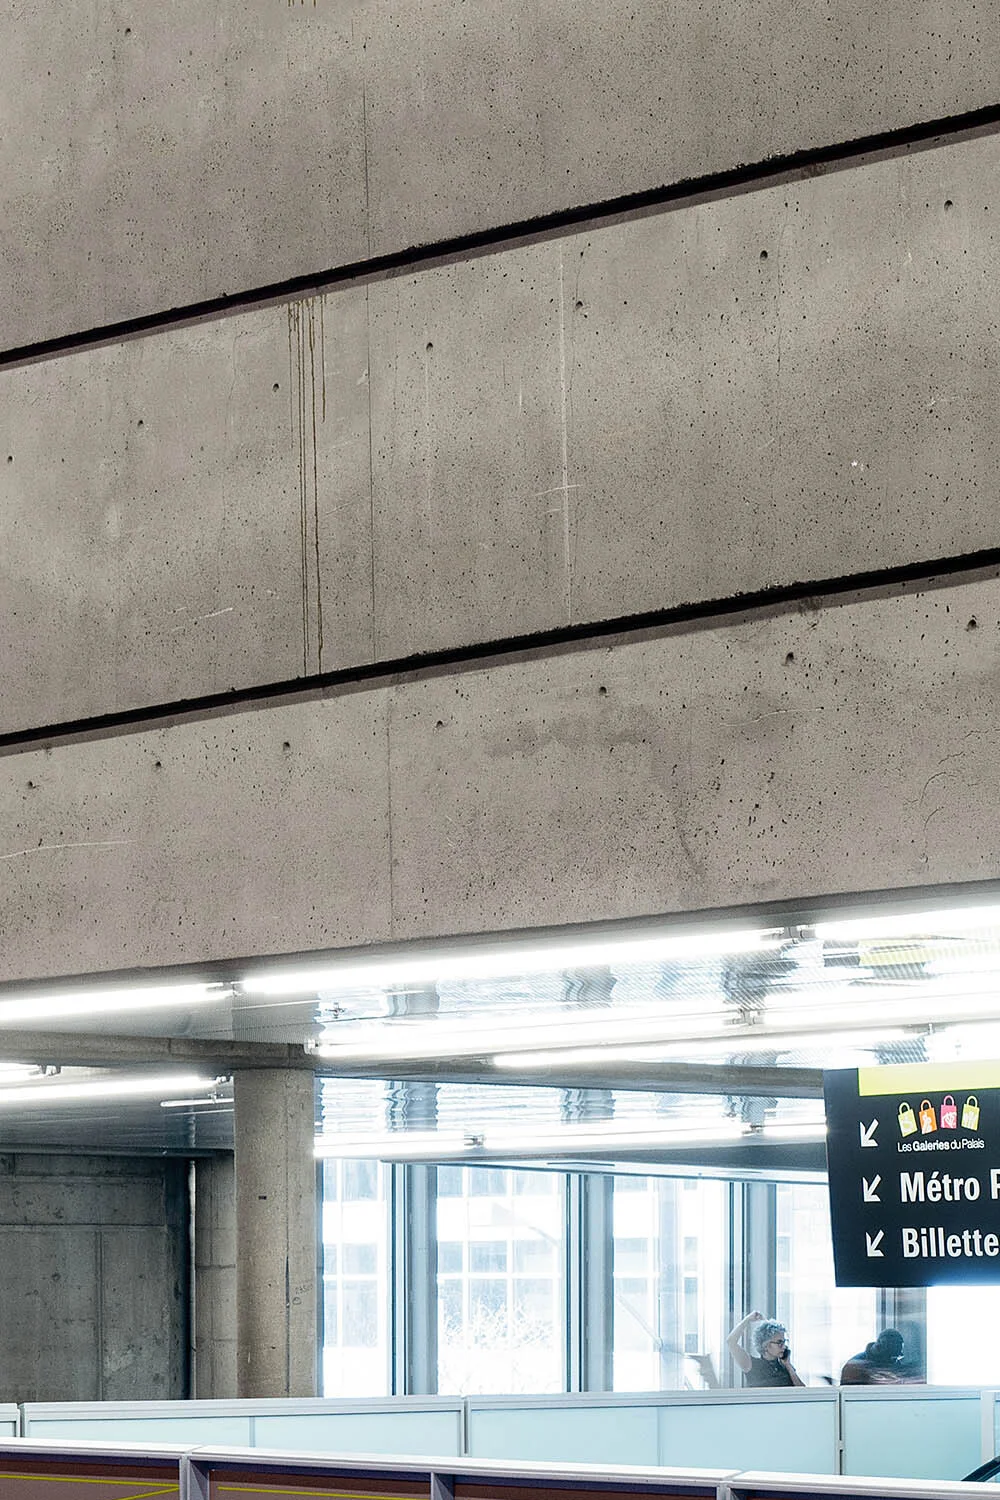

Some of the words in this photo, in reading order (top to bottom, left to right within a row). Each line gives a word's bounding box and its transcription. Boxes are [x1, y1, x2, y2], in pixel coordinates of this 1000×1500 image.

[897, 1142, 912, 1152] Les
[912, 1139, 950, 1151] Galeries
[950, 1139, 961, 1150] du
[962, 1138, 985, 1149] Palais
[900, 1172, 980, 1202] Métro
